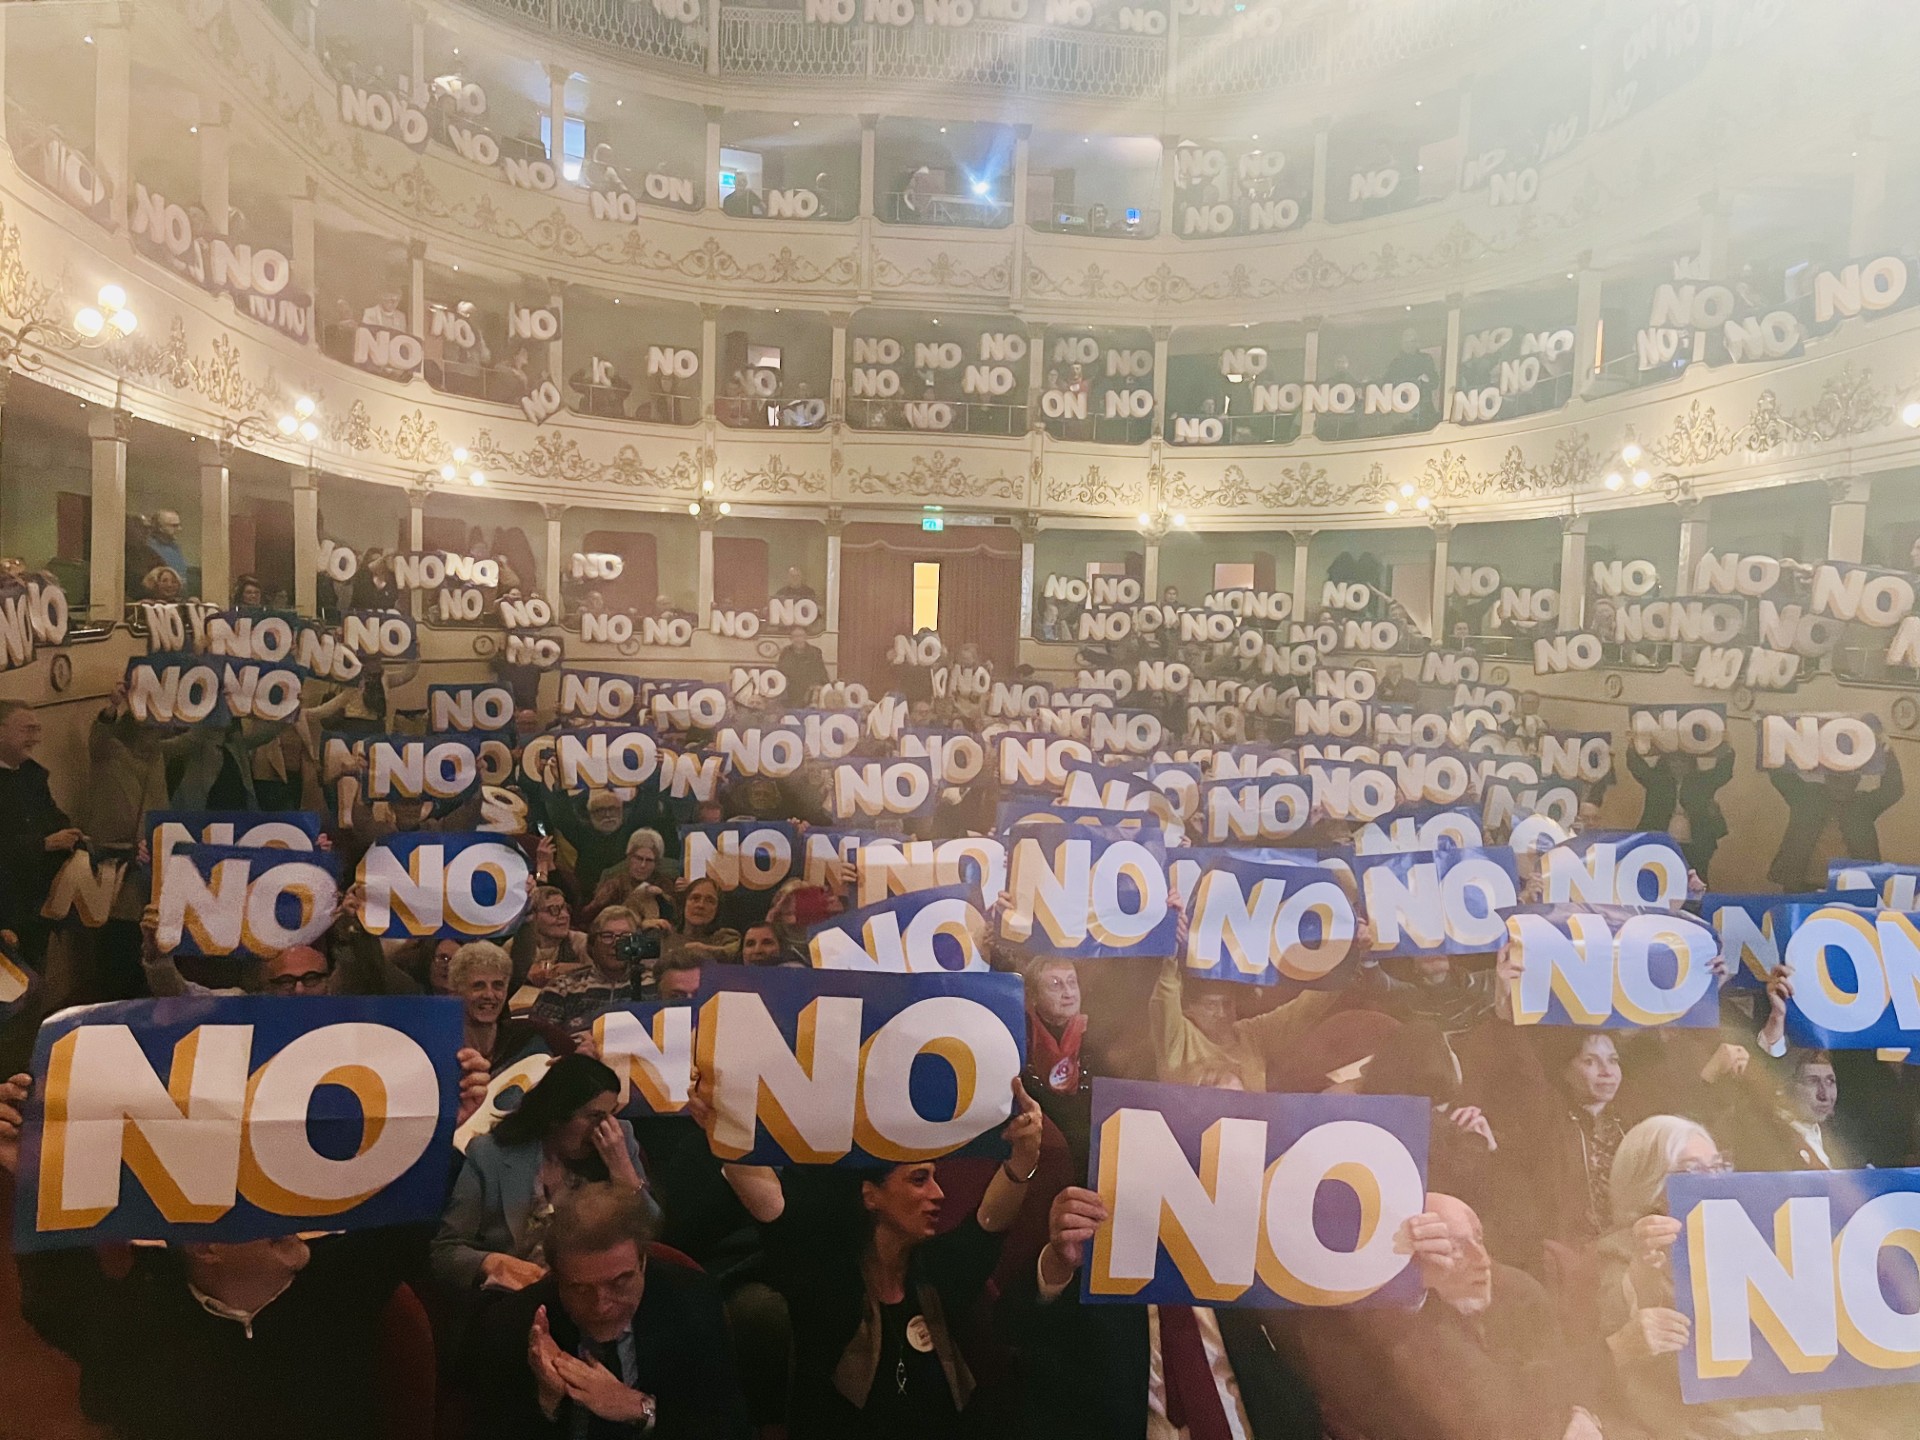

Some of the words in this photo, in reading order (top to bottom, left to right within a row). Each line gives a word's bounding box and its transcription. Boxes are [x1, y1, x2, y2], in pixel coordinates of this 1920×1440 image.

[1120, 9, 1167, 34] NO
[341, 84, 394, 132] NO
[448, 123, 499, 166] NO
[505, 157, 556, 190] NO
[1349, 169, 1399, 202] NO
[1490, 168, 1539, 206] NO
[133, 182, 192, 255] NO
[590, 190, 637, 222] NO
[768, 190, 818, 217] NO
[1185, 204, 1234, 234] NO
[1249, 199, 1298, 231] NO
[211, 239, 289, 296] NO
[1649, 284, 1735, 330] NO
[1815, 256, 1908, 322] NO
[430, 310, 475, 348] NO
[509, 307, 557, 341] NO
[1724, 310, 1801, 362] NO
[354, 326, 422, 370] NO
[648, 346, 698, 378] NO
[853, 338, 900, 364] NO
[915, 343, 962, 369] NO
[980, 333, 1027, 361] NO
[1055, 338, 1099, 364] NO
[1221, 347, 1267, 375] NO
[1462, 327, 1513, 361] NO
[1520, 329, 1575, 358] NO
[963, 365, 1014, 395] NO
[1107, 349, 1152, 377] NO
[1502, 357, 1540, 395] NO
[852, 368, 900, 397] NO
[1253, 384, 1301, 413] NO
[1302, 383, 1356, 414] NO
[1365, 382, 1420, 414] NO
[521, 381, 561, 425] NO
[905, 403, 952, 429] NO
[1106, 389, 1153, 418] NO
[1453, 387, 1502, 422] NO
[1175, 418, 1224, 443] NO
[394, 555, 446, 590] NO
[445, 552, 499, 588] NO
[572, 552, 623, 580] NO
[1446, 565, 1501, 598] NO
[1592, 560, 1656, 597] NO
[1693, 552, 1780, 596] NO
[441, 588, 483, 620] NO
[1044, 574, 1088, 603] NO
[1094, 577, 1141, 605] NO
[1243, 590, 1292, 621] NO
[1323, 581, 1370, 611] NO
[1502, 586, 1561, 621] NO
[1812, 565, 1915, 628] NO
[501, 599, 551, 629] NO
[581, 613, 633, 643] NO
[643, 617, 692, 646] NO
[711, 610, 760, 640] NO
[769, 598, 818, 627] NO
[1080, 611, 1131, 641] NO
[1182, 613, 1235, 642] NO
[1615, 602, 1669, 645] NO
[1668, 602, 1742, 644] NO
[1759, 600, 1842, 657] NO
[206, 618, 293, 662] NO
[295, 628, 362, 681] NO
[344, 615, 412, 657] NO
[506, 635, 561, 667] NO
[895, 633, 942, 667] NO
[1290, 624, 1338, 654] NO
[1344, 620, 1399, 651] NO
[1534, 633, 1602, 675] NO
[1138, 660, 1191, 693] NO
[1262, 644, 1317, 677] NO
[1422, 651, 1479, 682] NO
[1694, 648, 1744, 690] NO
[1746, 649, 1800, 690] NO
[129, 664, 219, 722] NO
[223, 662, 301, 720] NO
[560, 674, 635, 719] NO
[732, 668, 787, 701] NO
[988, 682, 1050, 718] NO
[1316, 668, 1376, 701] NO
[432, 688, 514, 732] NO
[651, 688, 726, 731] NO
[1294, 699, 1364, 737] NO
[1454, 684, 1516, 724] NO
[1091, 711, 1162, 753] NO
[1373, 712, 1449, 749] NO
[1632, 709, 1726, 754] NO
[1762, 715, 1877, 772] NO
[369, 742, 477, 797] NO
[557, 733, 657, 790] NO
[717, 728, 804, 777] NO
[900, 735, 984, 784] NO
[1000, 736, 1093, 785] NO
[1540, 738, 1613, 780] NO
[834, 762, 930, 817] NO
[1304, 763, 1398, 822] NO
[1383, 749, 1469, 804] NO
[1208, 783, 1310, 842] NO
[684, 828, 792, 892] NO
[857, 838, 1005, 908] NO
[1542, 843, 1688, 911] NO
[154, 854, 339, 956] NO
[354, 842, 532, 935] NO
[1002, 838, 1168, 950] NO
[1362, 857, 1518, 948] NO
[810, 899, 990, 973] NO
[1186, 868, 1355, 981] NO
[1509, 914, 1719, 1026] NO
[698, 991, 1021, 1164] NO
[36, 1022, 440, 1232] NO
[1090, 1107, 1425, 1307] NO
[1686, 1191, 1920, 1378] NO
